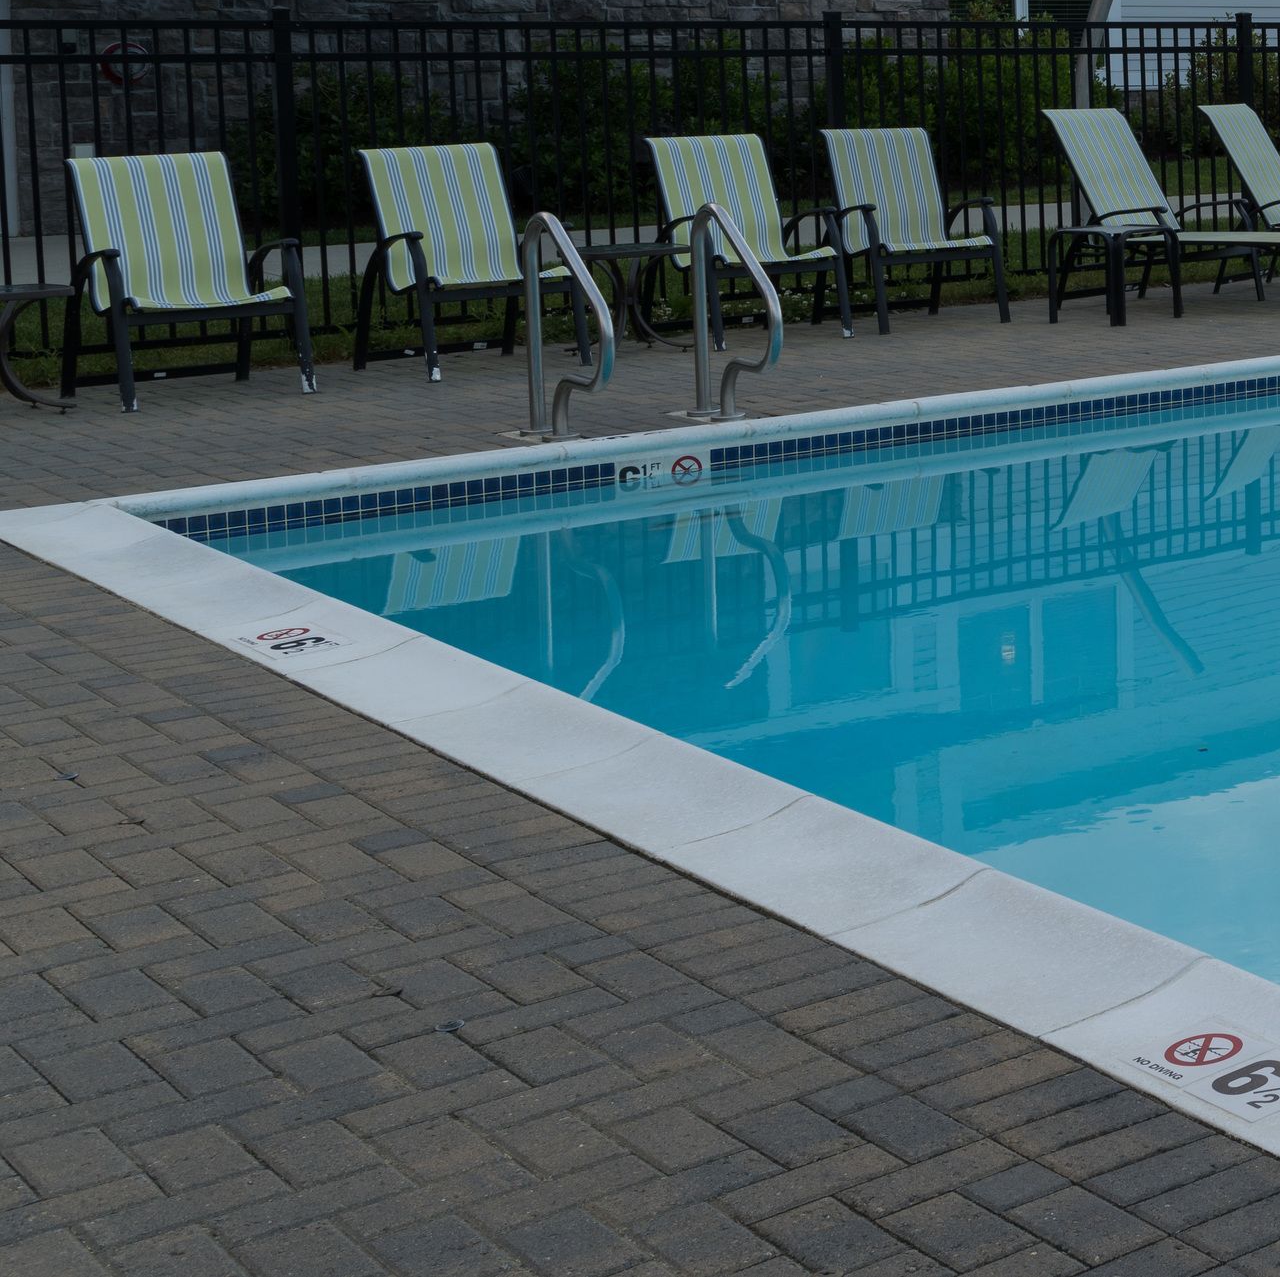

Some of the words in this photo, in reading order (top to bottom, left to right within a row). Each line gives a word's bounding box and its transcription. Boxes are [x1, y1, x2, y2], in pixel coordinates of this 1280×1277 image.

[650, 462, 661, 471] FT
[270, 636, 326, 650] 6
[1132, 1056, 1151, 1066] NO
[1148, 1063, 1184, 1081] DIVING
